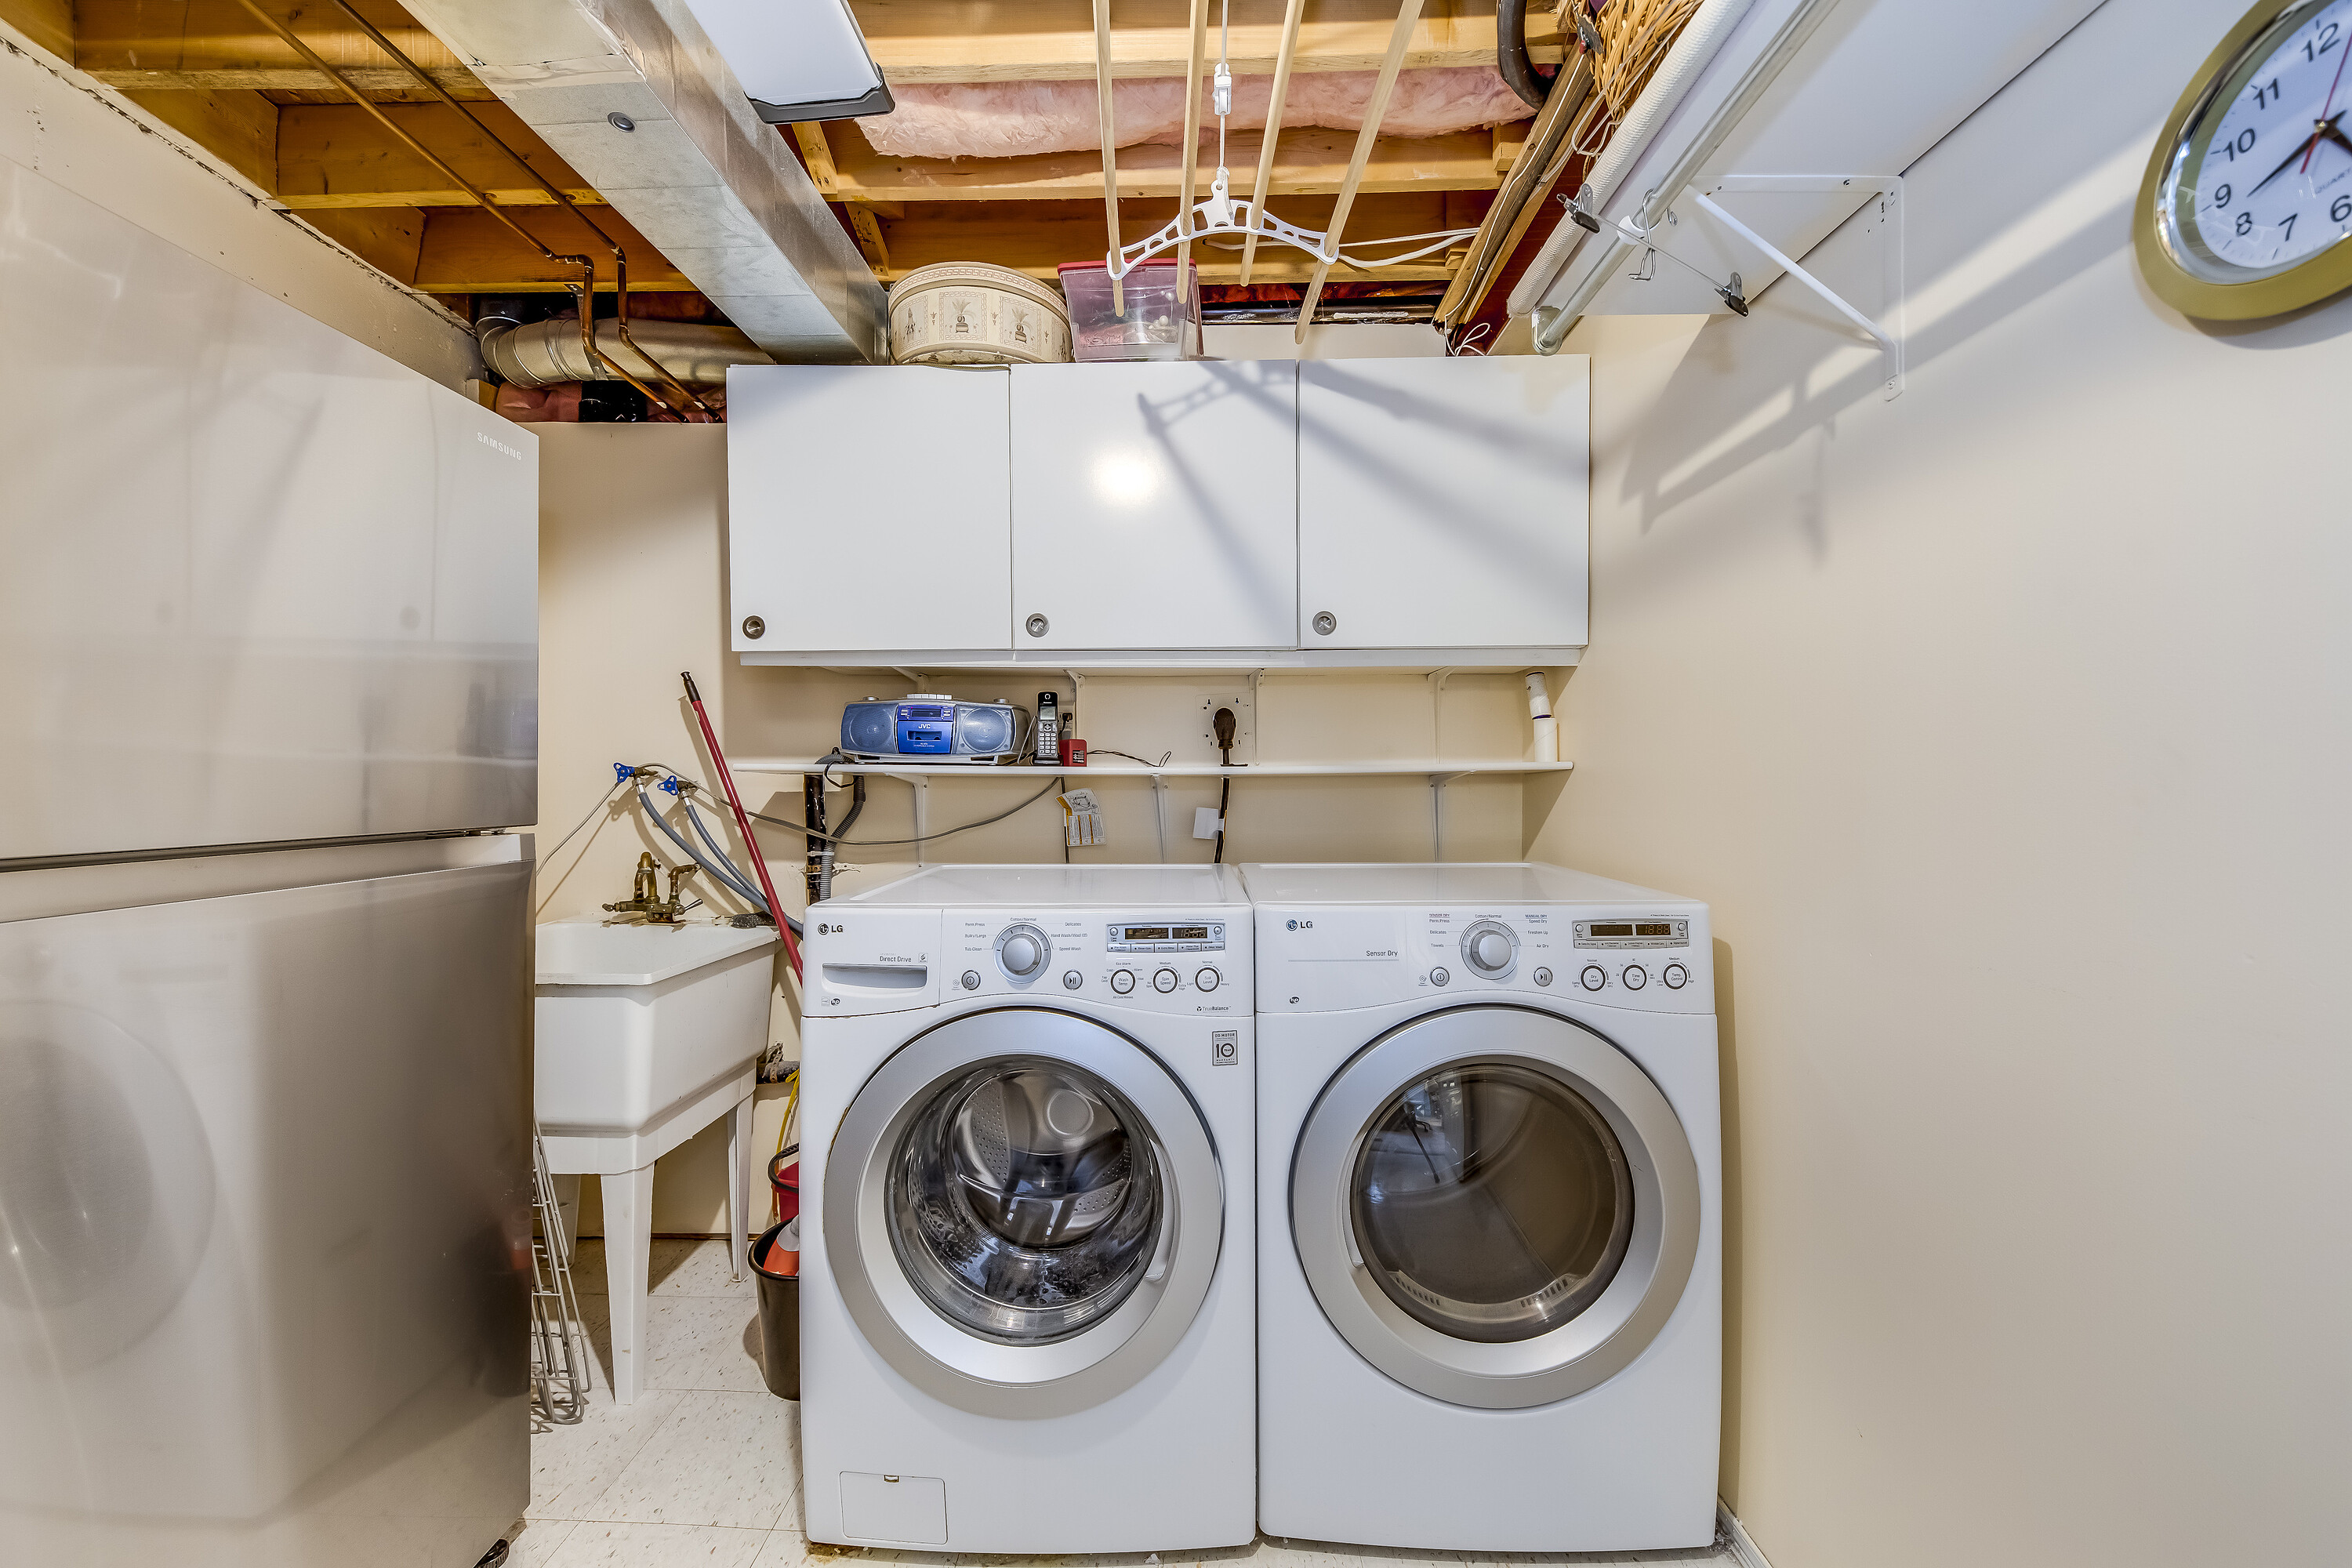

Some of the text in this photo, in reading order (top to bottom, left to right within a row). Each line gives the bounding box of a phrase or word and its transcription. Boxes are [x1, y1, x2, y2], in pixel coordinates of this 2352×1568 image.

[2301, 22, 2340, 63] 12
[2252, 78, 2281, 111] 11
[2222, 128, 2256, 162] 10
[2214, 183, 2231, 209] 9
[2330, 194, 2352, 223] 6
[2235, 212, 2253, 236] 8
[2278, 212, 2299, 241] 7
[477, 431, 522, 461] SAMSUNG
[831, 924, 844, 933] LG
[1300, 920, 1313, 929] LG
[1215, 1043, 1235, 1058] 10
